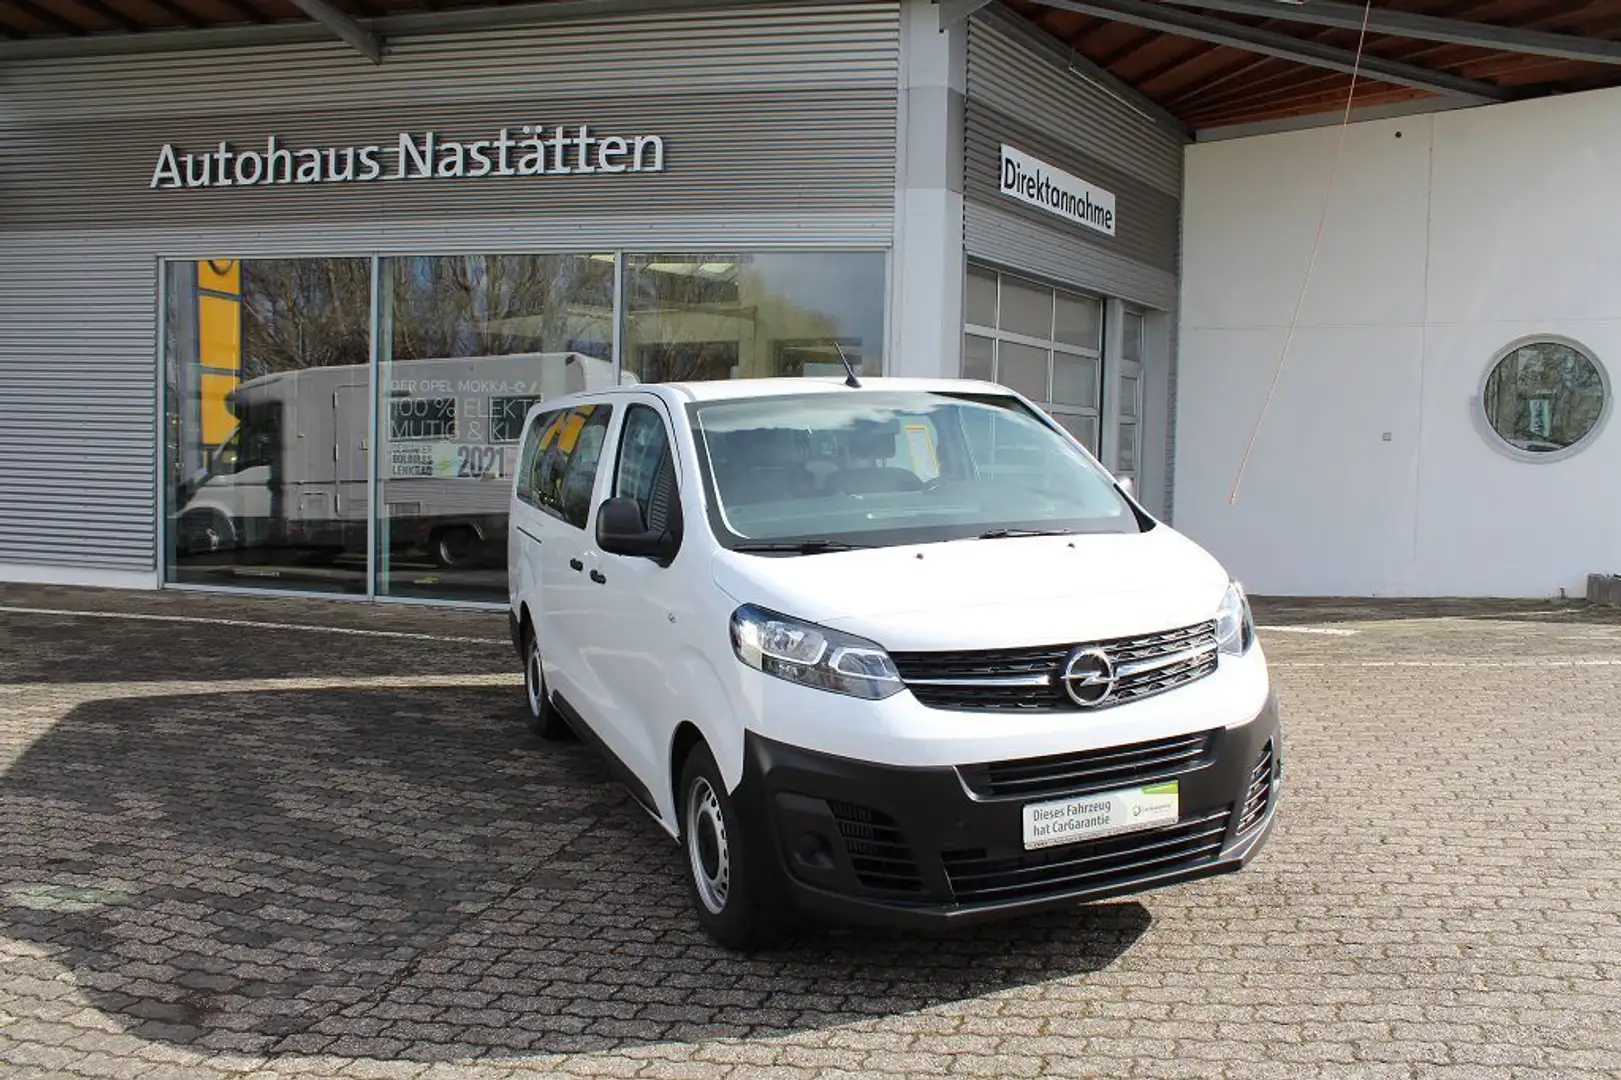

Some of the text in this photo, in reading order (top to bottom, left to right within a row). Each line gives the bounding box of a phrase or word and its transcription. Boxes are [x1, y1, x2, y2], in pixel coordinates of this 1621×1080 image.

[150, 124, 664, 189] Autohaus Nastätten
[1004, 157, 1112, 229] Direktannahme
[391, 380, 417, 392] DER
[420, 379, 453, 392] OPEL
[394, 398, 428, 417] 100
[391, 420, 460, 440] MUTIG
[468, 421, 484, 440] &
[457, 446, 506, 477] 2021
[1033, 800, 1111, 822] Dieses Fahrzeug
[1033, 824, 1050, 837] hat
[1052, 814, 1110, 833] CarGarantie
